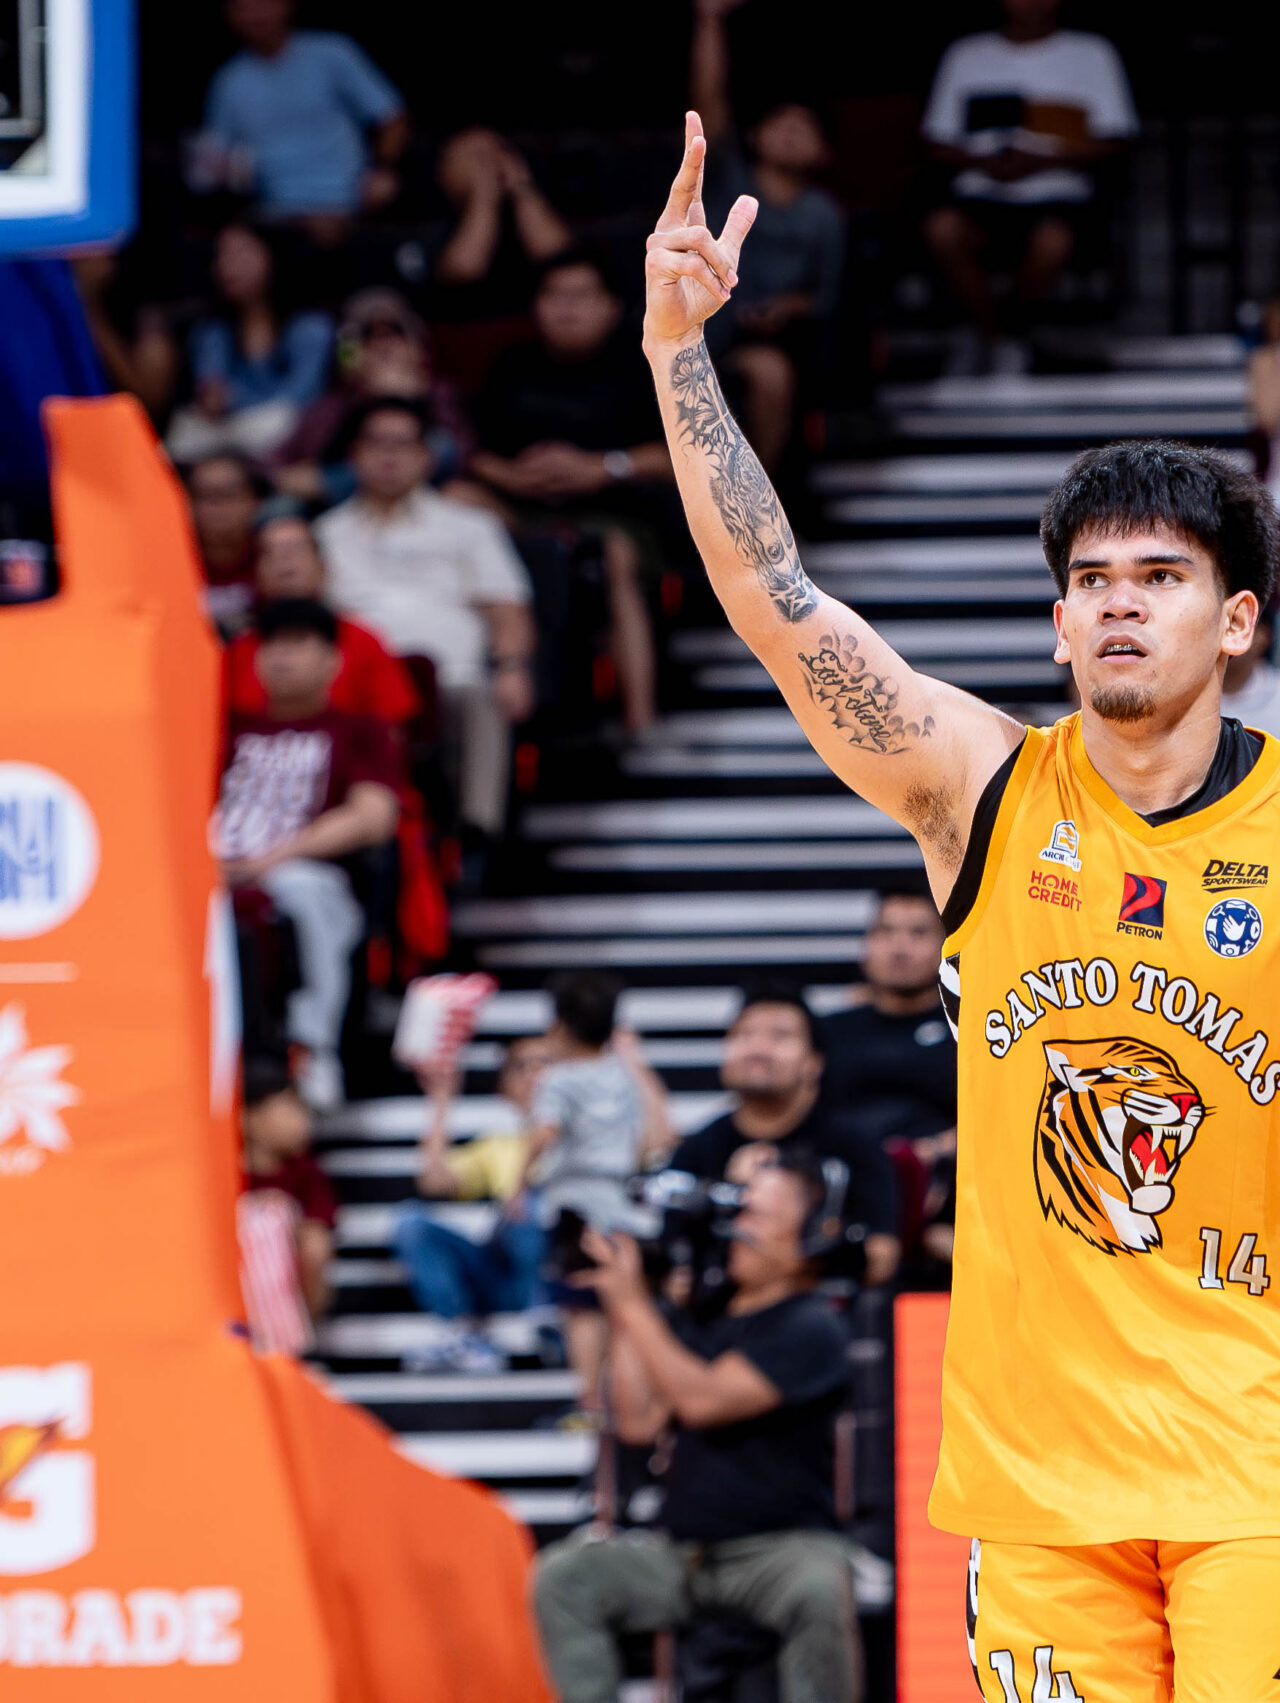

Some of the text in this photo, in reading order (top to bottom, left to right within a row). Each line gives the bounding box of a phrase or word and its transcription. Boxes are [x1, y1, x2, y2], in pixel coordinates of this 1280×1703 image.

[1201, 877, 1268, 887] SPORTSWEAR
[1202, 859, 1270, 879] DELTA
[1031, 870, 1079, 896] HOME
[1028, 886, 1083, 912] CREDIT
[1116, 922, 1163, 941] PETRON
[985, 957, 1118, 1059] SANTO
[1199, 1227, 1271, 1296] 14
[0, 1587, 242, 1667] RADE
